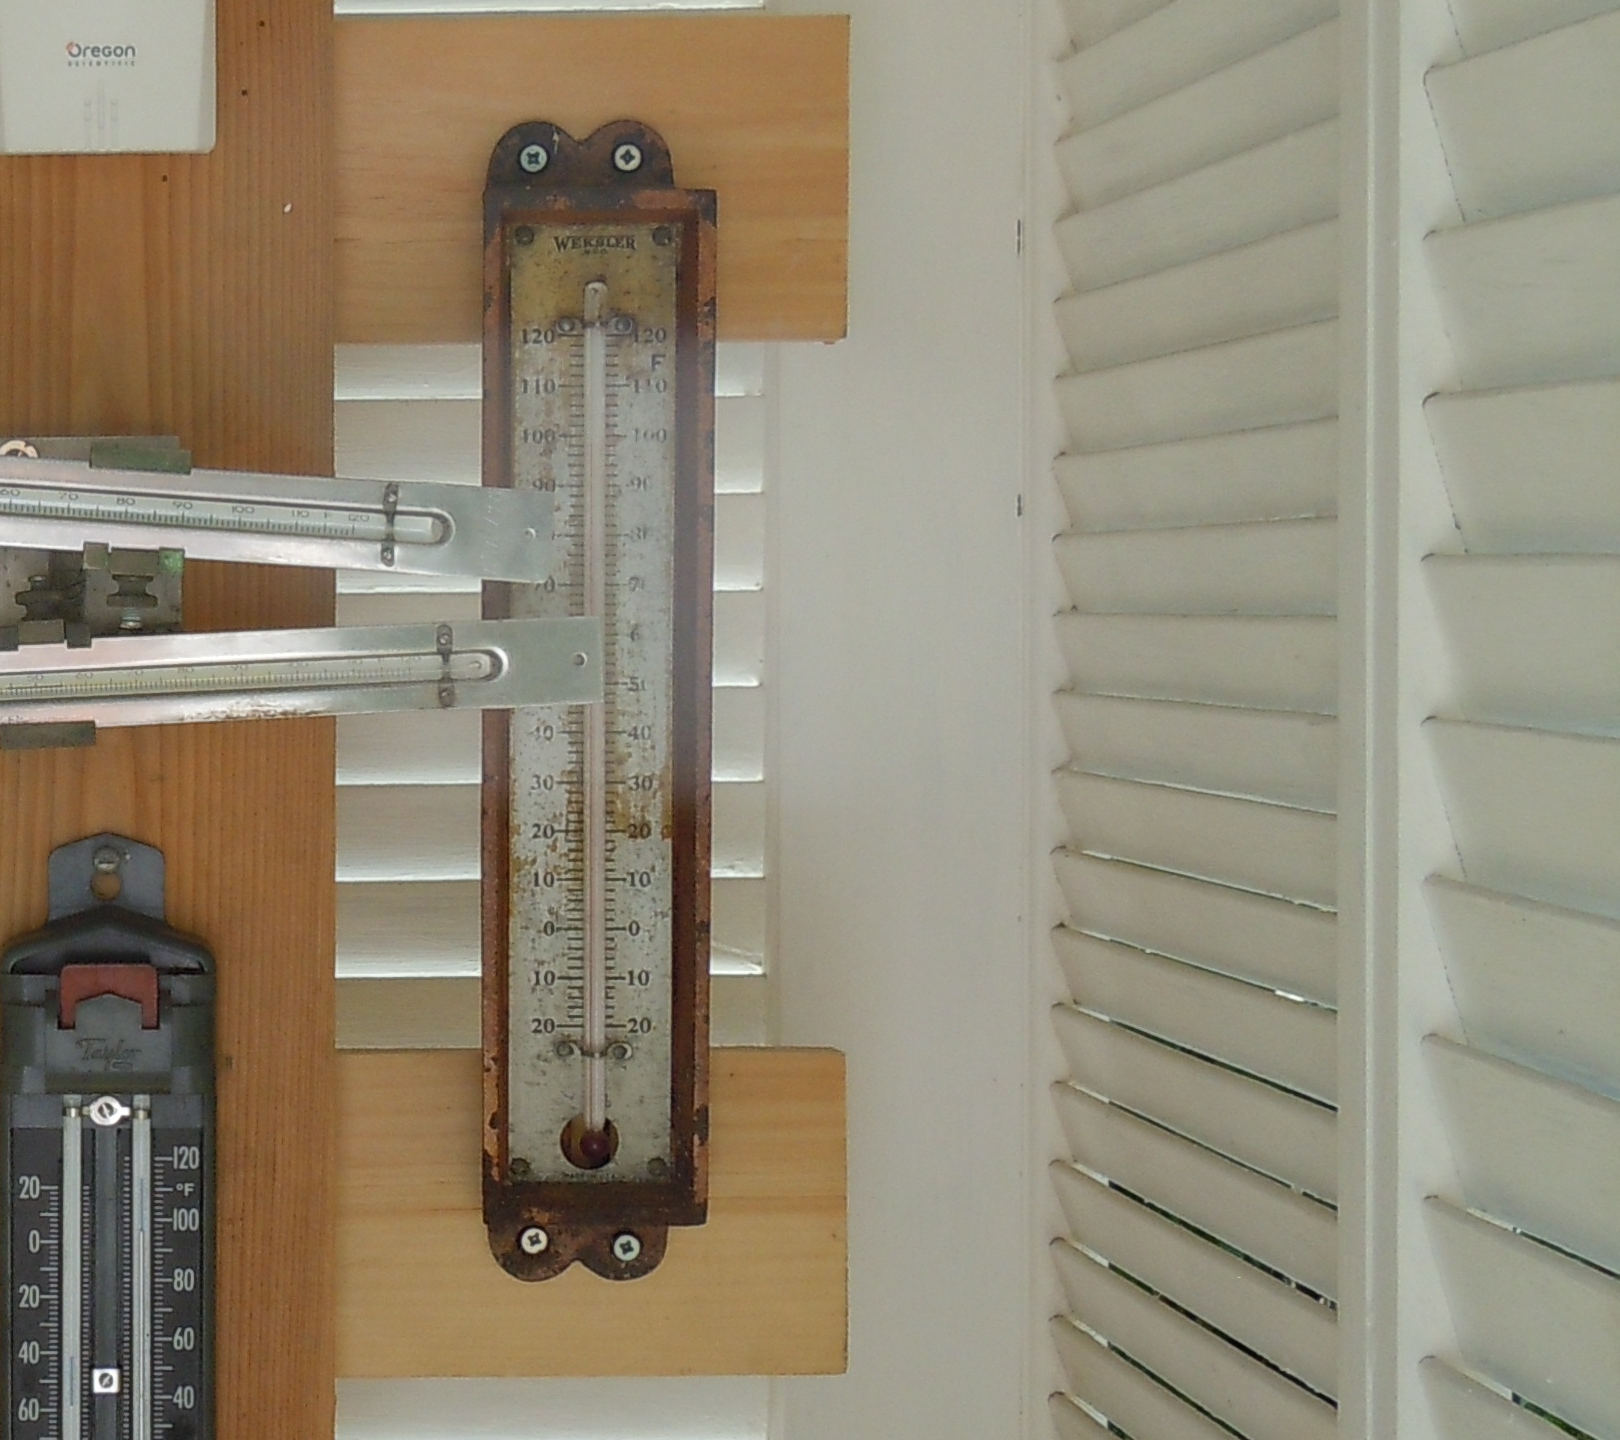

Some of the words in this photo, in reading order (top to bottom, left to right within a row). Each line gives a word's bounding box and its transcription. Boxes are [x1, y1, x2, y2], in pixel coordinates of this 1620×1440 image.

[522, 329, 555, 344] 120
[633, 328, 667, 343] 120
[522, 379, 556, 394] 110
[522, 428, 555, 444] 100
[0, 488, 21, 497] 60
[58, 492, 79, 501] 70
[116, 497, 136, 506] 80
[172, 501, 193, 510] 90
[231, 506, 255, 514] 100
[628, 725, 651, 741] 40
[531, 774, 554, 791] 30
[629, 774, 653, 791] 30
[531, 823, 554, 839] 20
[628, 823, 651, 839] 20
[533, 872, 555, 887] 10
[629, 872, 651, 887] 10
[543, 921, 555, 937] 0
[629, 921, 640, 937] 0
[533, 971, 555, 986] 10
[628, 971, 650, 986] 10
[531, 1018, 555, 1034] 20
[628, 1018, 651, 1034] 20
[173, 1146, 200, 1169] 120
[19, 1176, 40, 1199] 20
[173, 1208, 200, 1231] 100
[29, 1230, 40, 1253] 0
[173, 1268, 195, 1291] 80
[19, 1285, 40, 1308] 20
[173, 1327, 195, 1350] 60
[18, 1341, 40, 1364] 40
[173, 1386, 195, 1409] 40
[18, 1398, 40, 1421] 60
